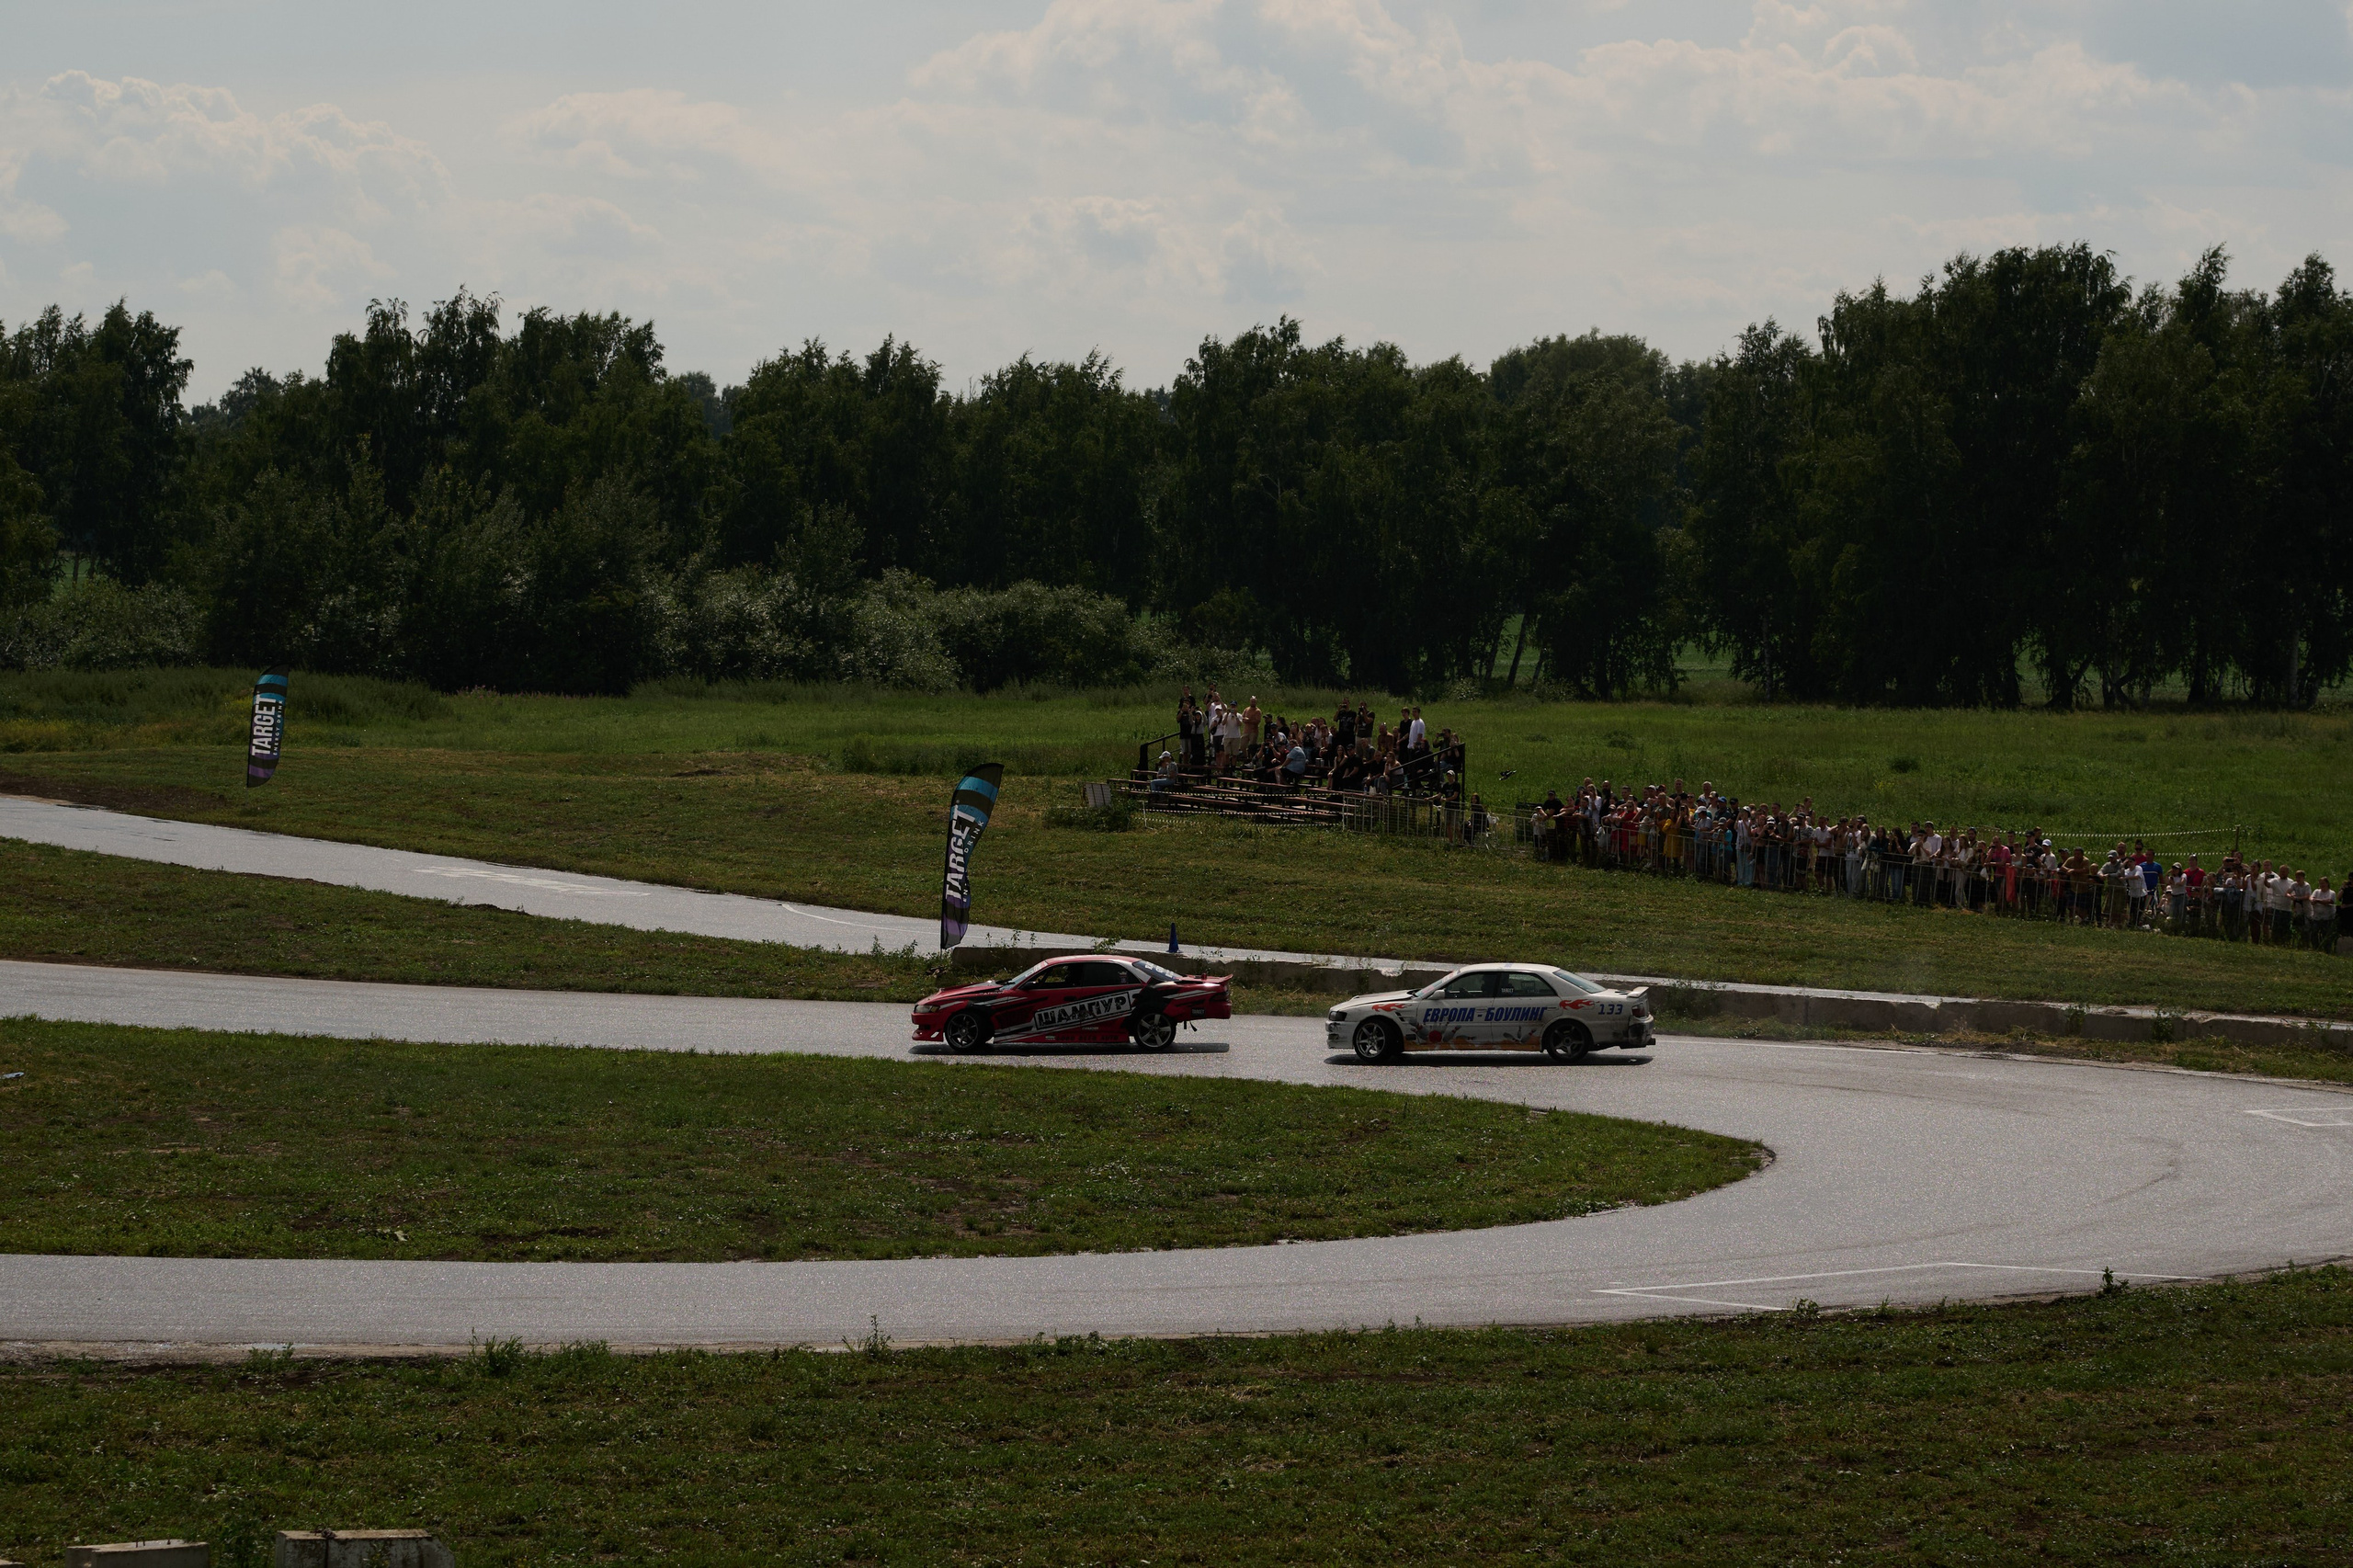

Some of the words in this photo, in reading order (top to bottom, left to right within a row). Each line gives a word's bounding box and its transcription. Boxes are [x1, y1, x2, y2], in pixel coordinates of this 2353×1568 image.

[251, 694, 277, 756] TARGET
[945, 804, 976, 900] TARGET
[964, 821, 984, 854] DRINK
[1037, 995, 1127, 1027] ШАМПУР
[1423, 1007, 1476, 1023] ЕВРОПА
[1483, 1006, 1548, 1022] БОУЛИНГ
[1597, 1004, 1623, 1016] 133
